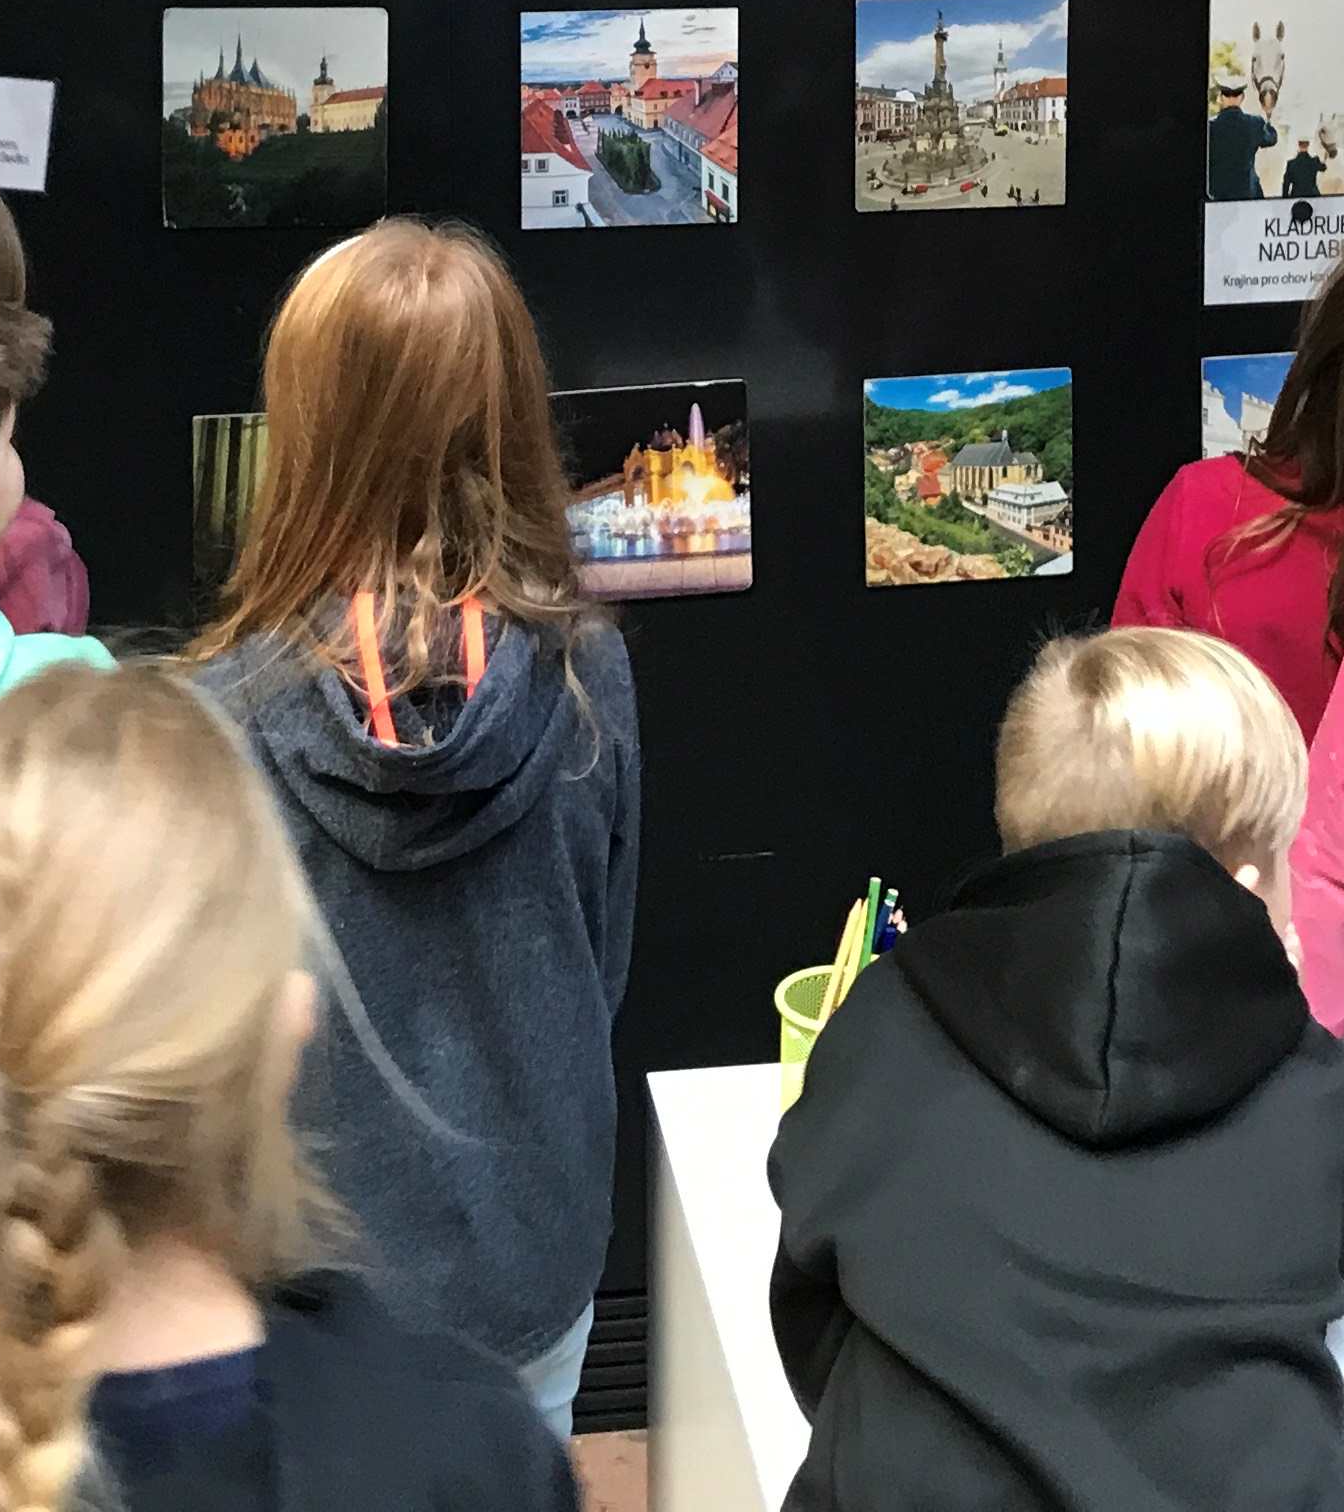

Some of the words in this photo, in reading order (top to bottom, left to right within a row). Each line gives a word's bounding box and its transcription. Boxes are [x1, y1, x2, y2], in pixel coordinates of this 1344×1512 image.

[1259, 242, 1299, 261] NAD
[1223, 275, 1259, 289] Krajina
[1261, 273, 1280, 286] pro
